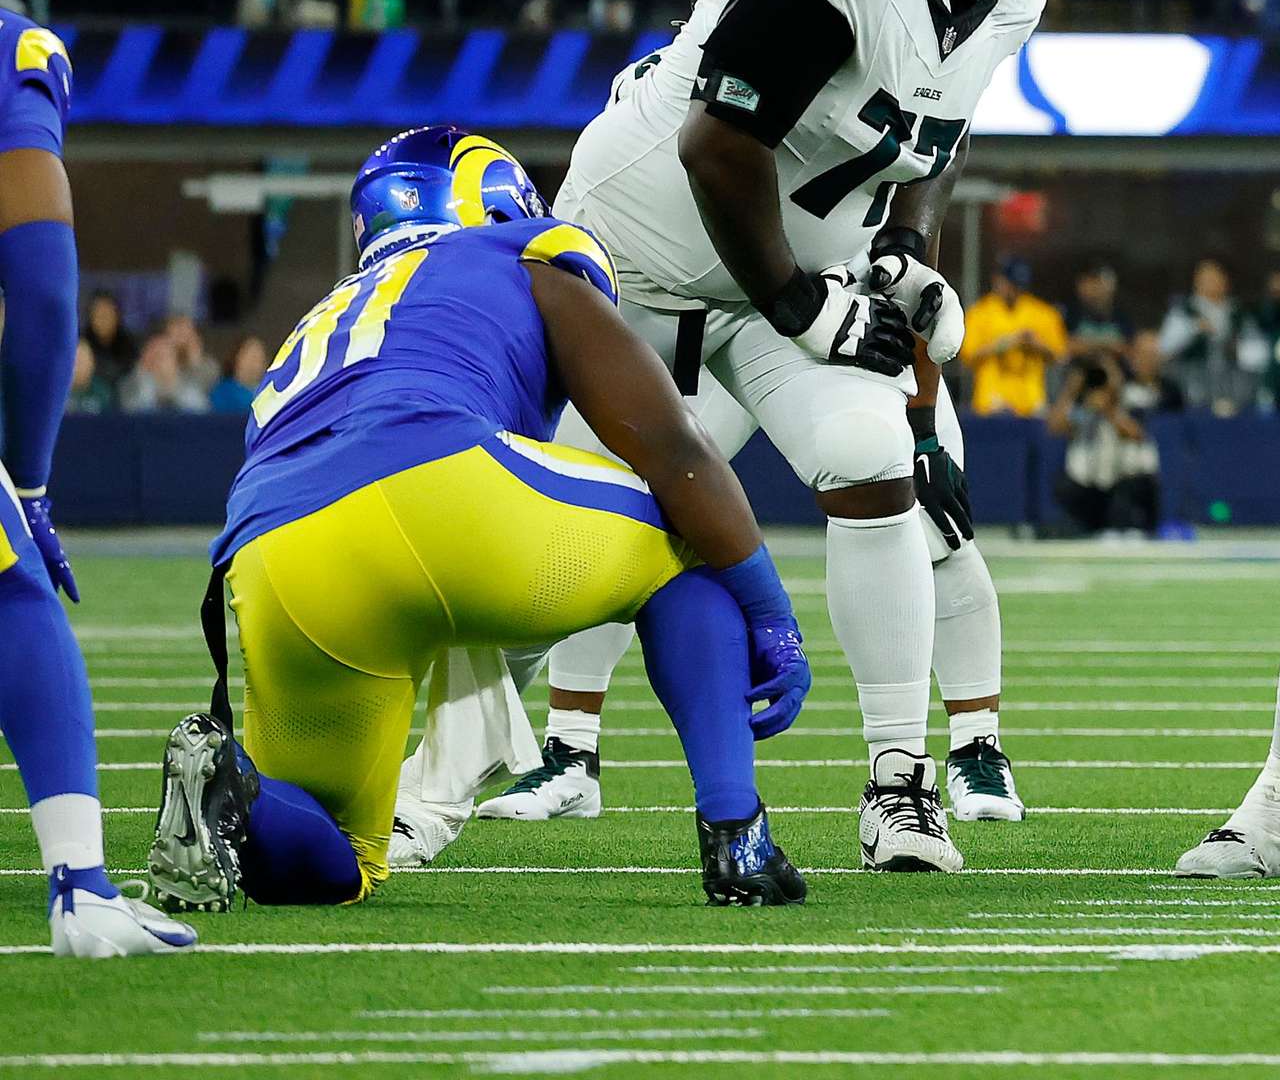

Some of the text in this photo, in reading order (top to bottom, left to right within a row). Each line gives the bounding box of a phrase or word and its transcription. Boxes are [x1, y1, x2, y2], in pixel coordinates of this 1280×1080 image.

[789, 87, 967, 227] 77
[913, 87, 943, 101] EAGLES
[251, 248, 430, 428] 91
